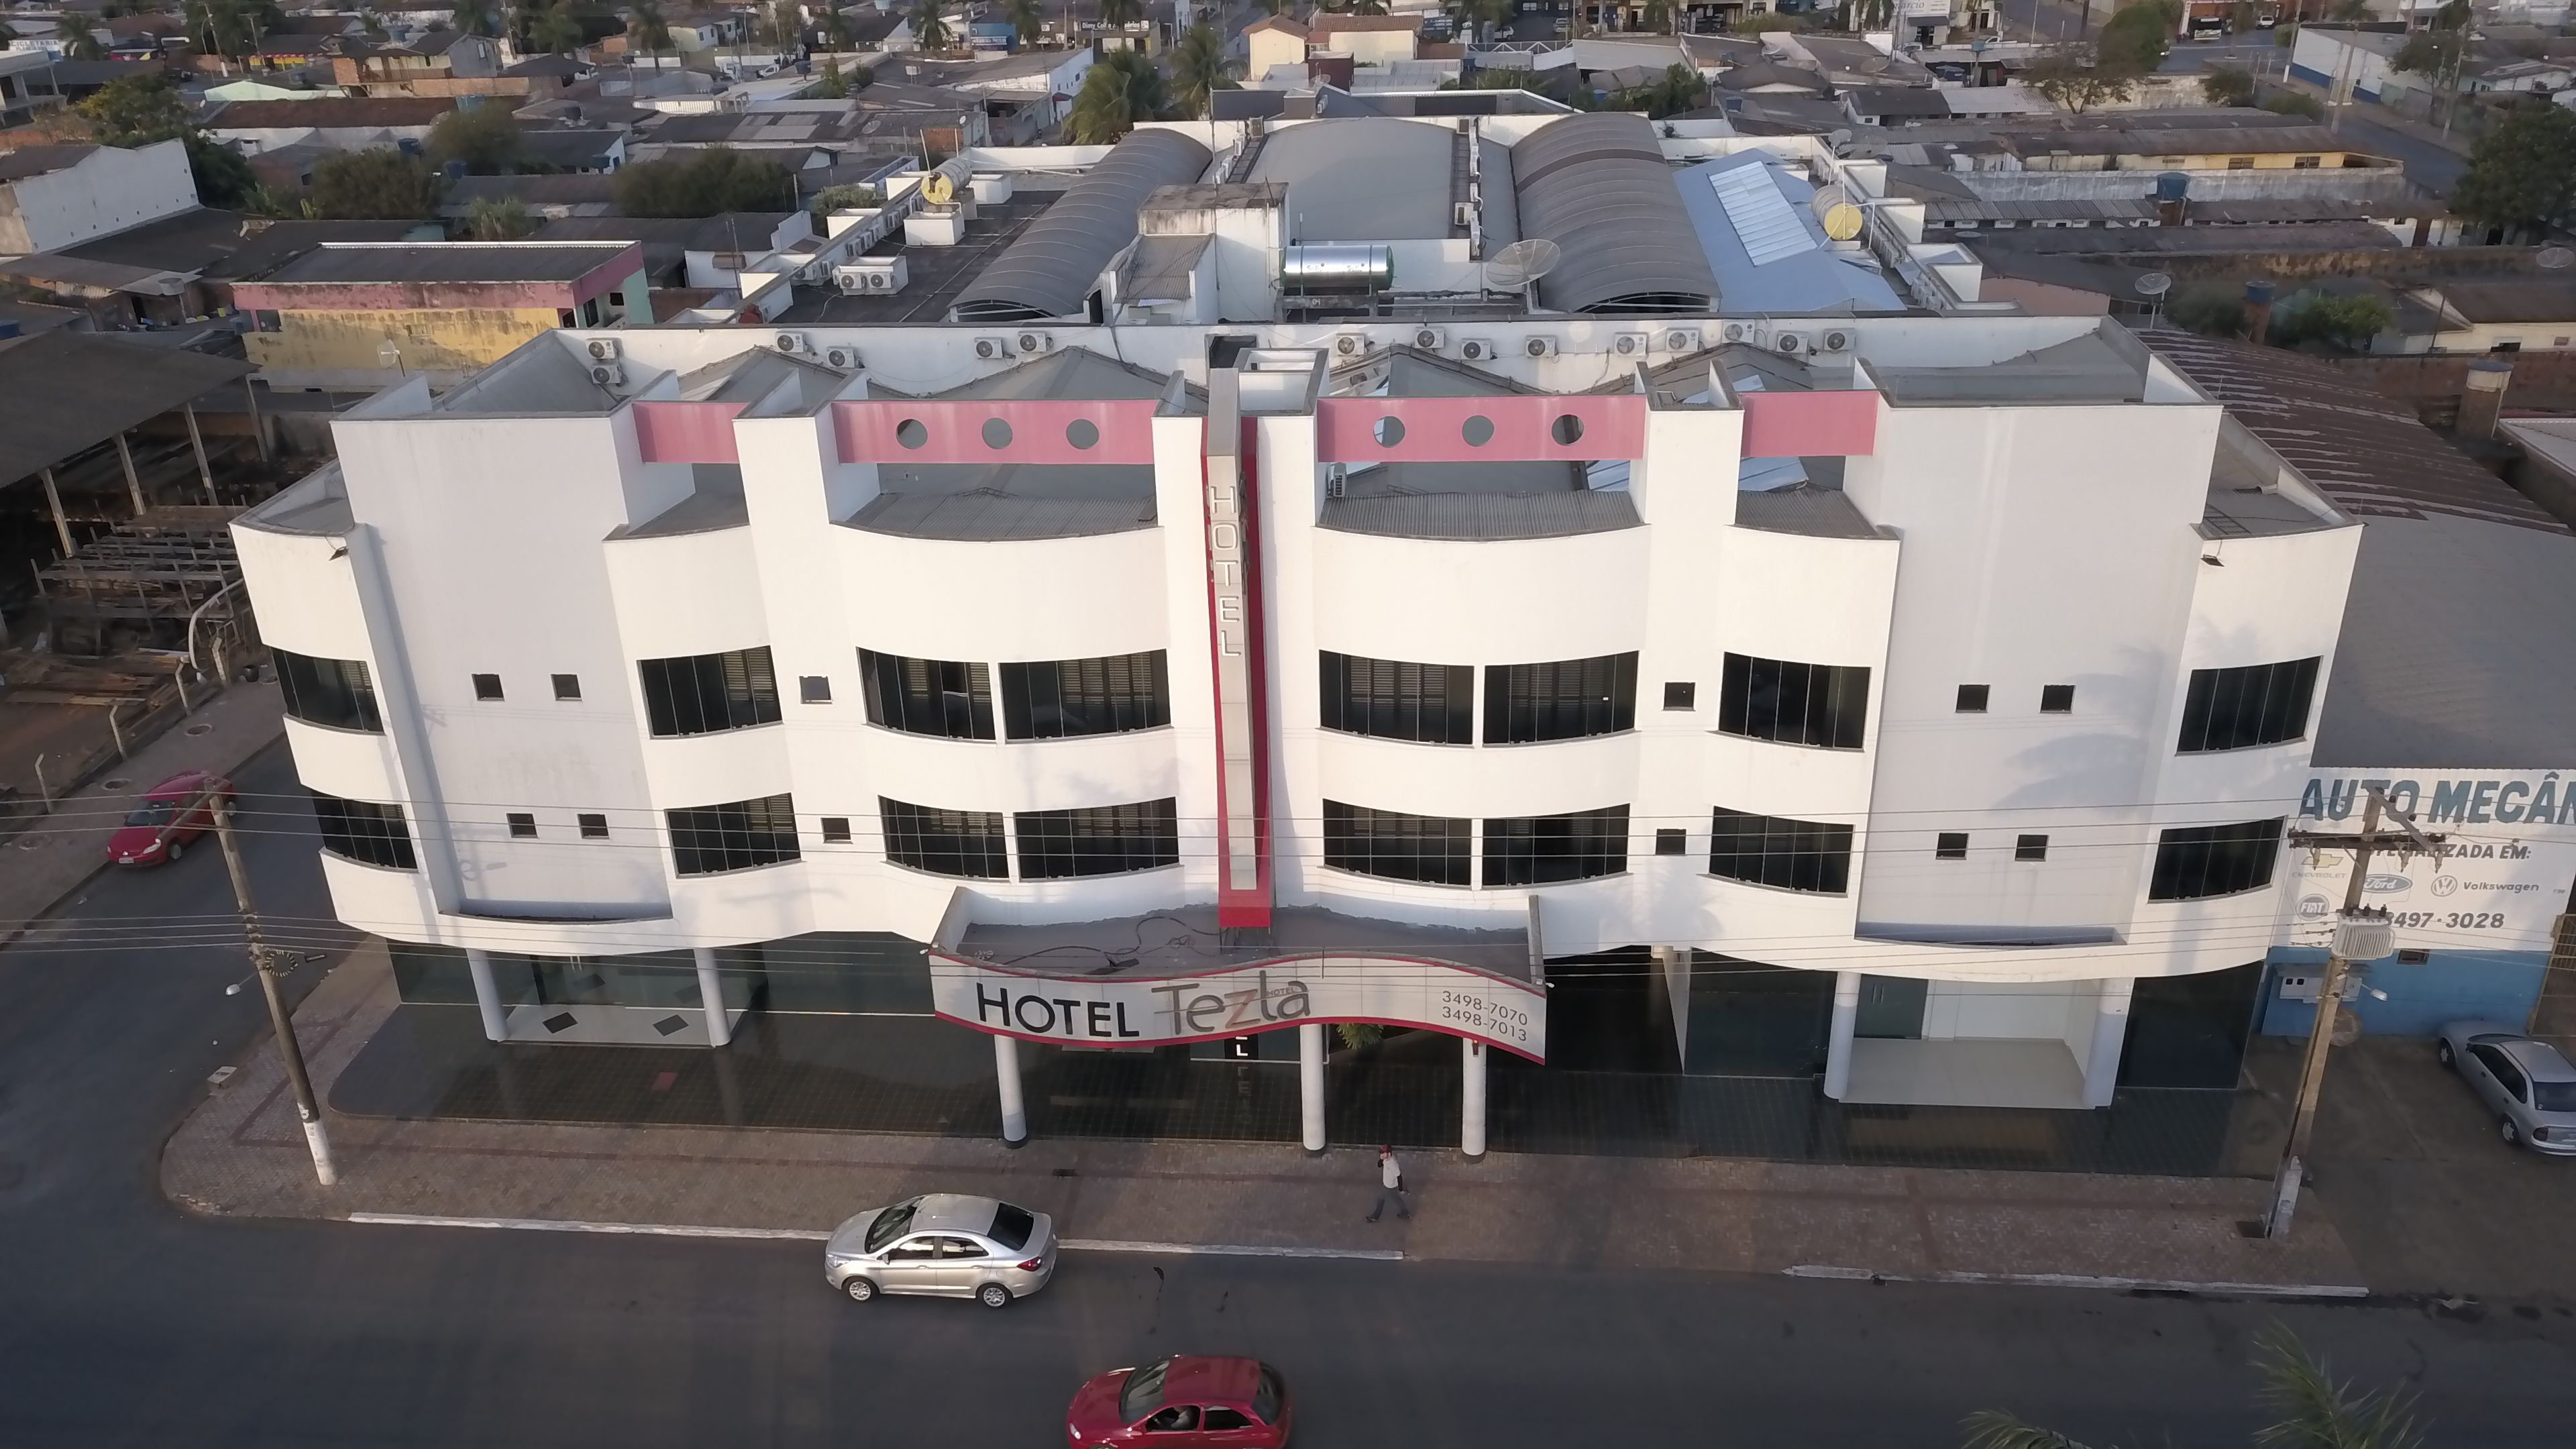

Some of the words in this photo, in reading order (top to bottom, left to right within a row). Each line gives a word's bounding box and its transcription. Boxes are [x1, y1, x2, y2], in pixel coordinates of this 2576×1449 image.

[1210, 486, 1241, 657] HOTEL
[2298, 779, 2420, 822] AUTO
[2364, 877, 2397, 889] Ford
[2463, 881, 2540, 894] Volkswagen
[2301, 902, 2325, 913] FIAT
[976, 982, 1140, 1037] HOTEL
[1151, 970, 1311, 1035] Tezla
[1267, 987, 1295, 996] HOTEL
[1442, 990, 1527, 1026] 3498-7070
[1442, 1006, 1527, 1041] 3498-7013
